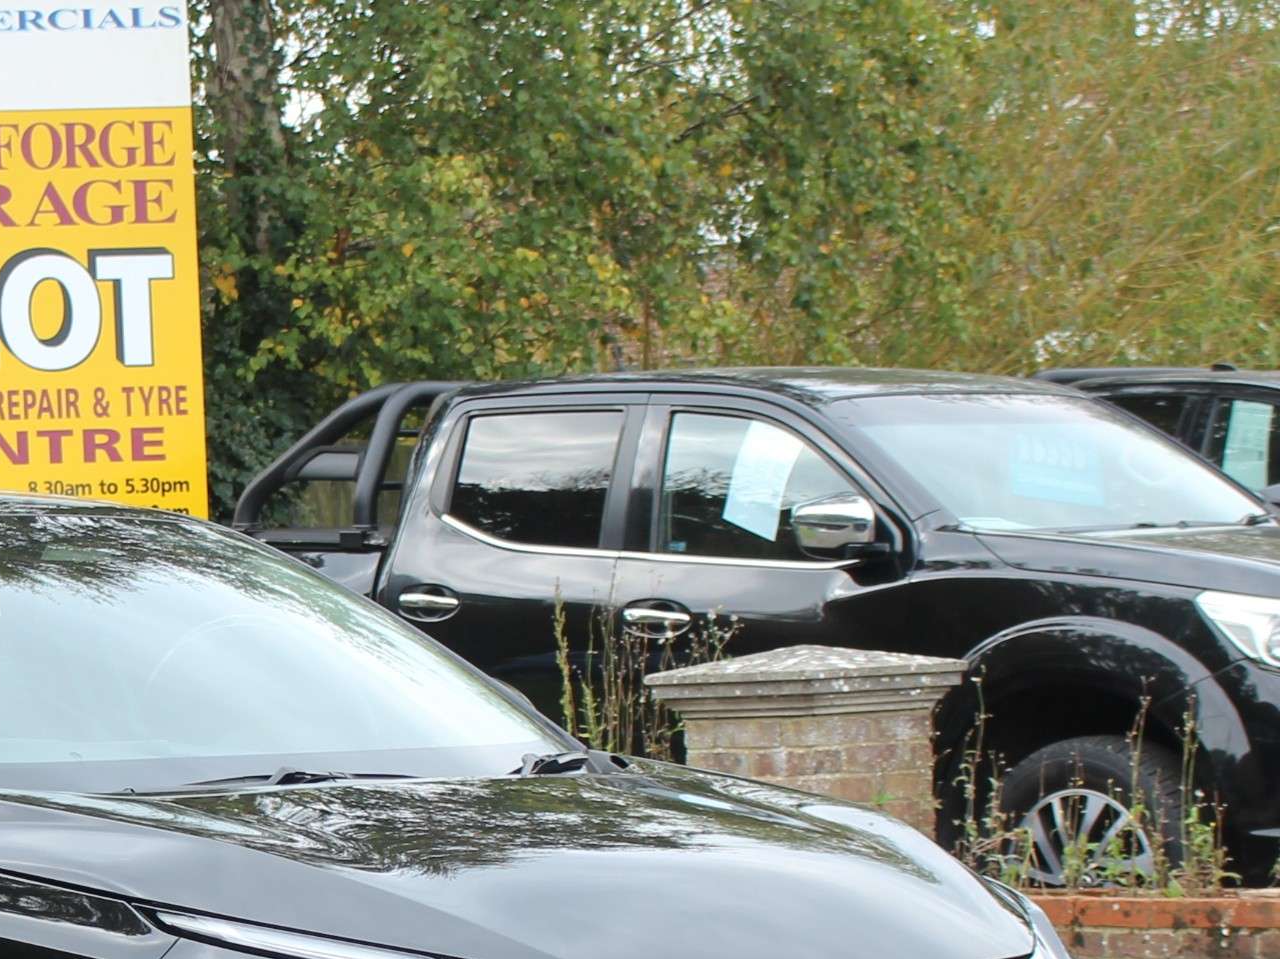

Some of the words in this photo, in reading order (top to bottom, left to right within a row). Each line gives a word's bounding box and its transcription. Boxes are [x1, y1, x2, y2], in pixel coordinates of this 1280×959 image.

[93, 386, 111, 418] &
[122, 385, 189, 417] TYRE
[28, 480, 92, 496] 830am
[99, 480, 118, 495] to
[125, 477, 190, 498] 5.30pm
